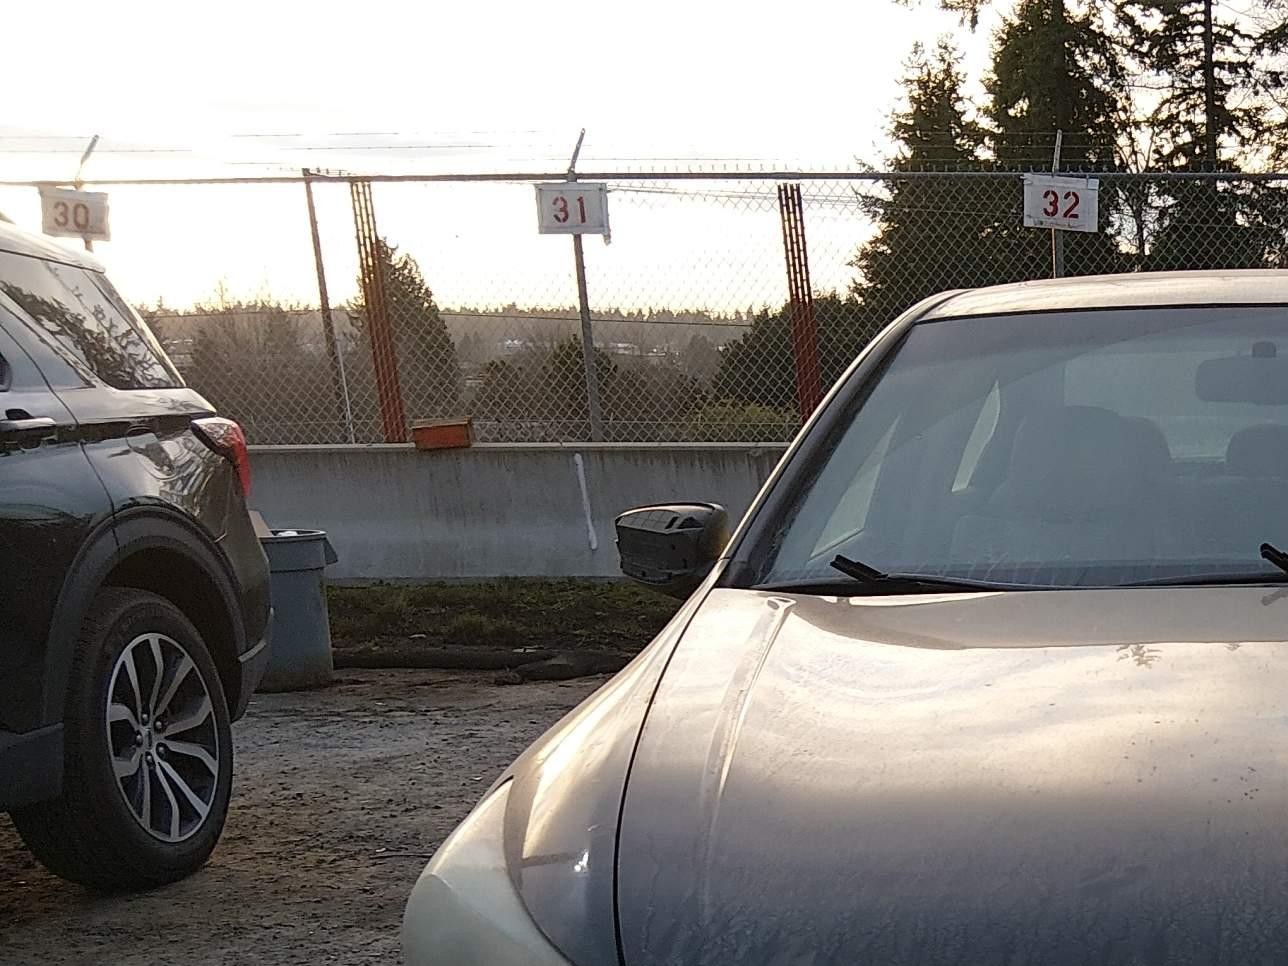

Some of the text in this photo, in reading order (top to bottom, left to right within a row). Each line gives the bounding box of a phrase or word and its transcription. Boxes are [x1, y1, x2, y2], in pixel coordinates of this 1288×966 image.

[53, 200, 89, 230] 30
[552, 195, 586, 224] 31
[1043, 189, 1080, 219] 32
